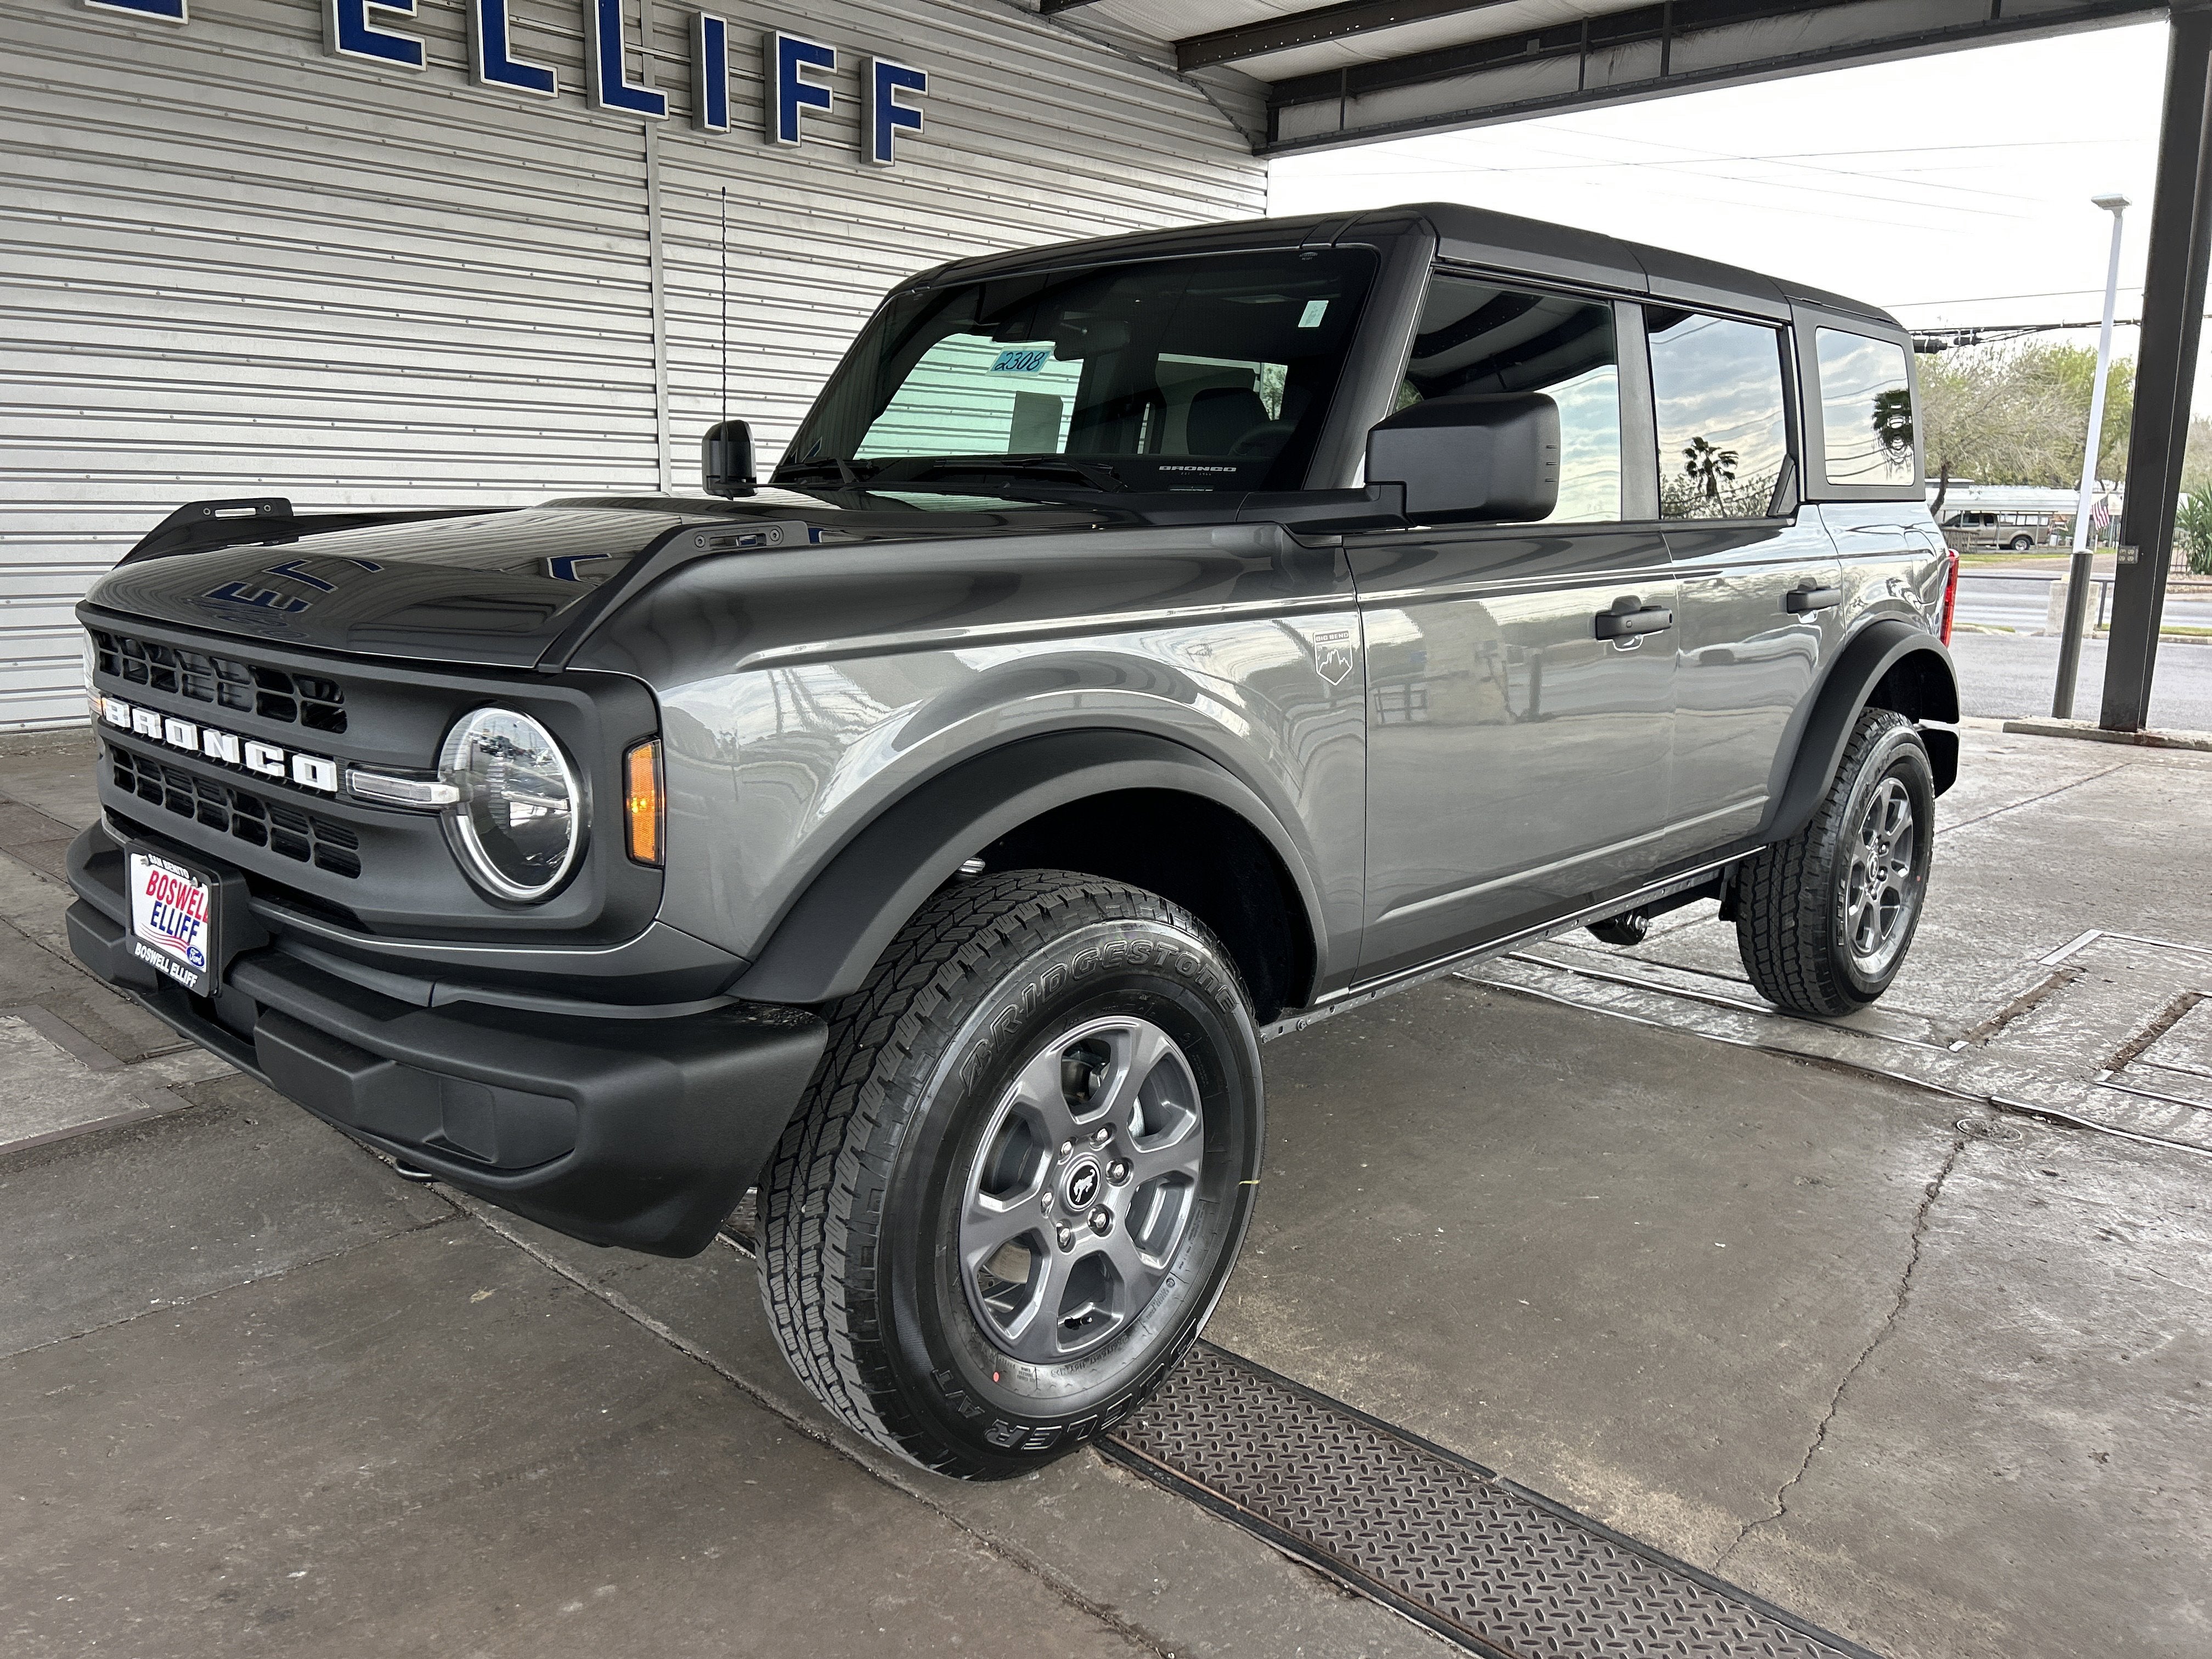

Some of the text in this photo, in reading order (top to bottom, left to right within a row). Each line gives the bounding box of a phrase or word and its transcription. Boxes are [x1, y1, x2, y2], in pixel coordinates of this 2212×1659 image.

[324, 0, 929, 166] ELLIFF
[994, 352, 1048, 371] 2308
[102, 697, 338, 792] BRONCO
[150, 900, 200, 945] ELLIFF
[134, 941, 198, 988] BOSWELL ELLIFF
[959, 939, 1239, 1097] BRIDGESTONE
